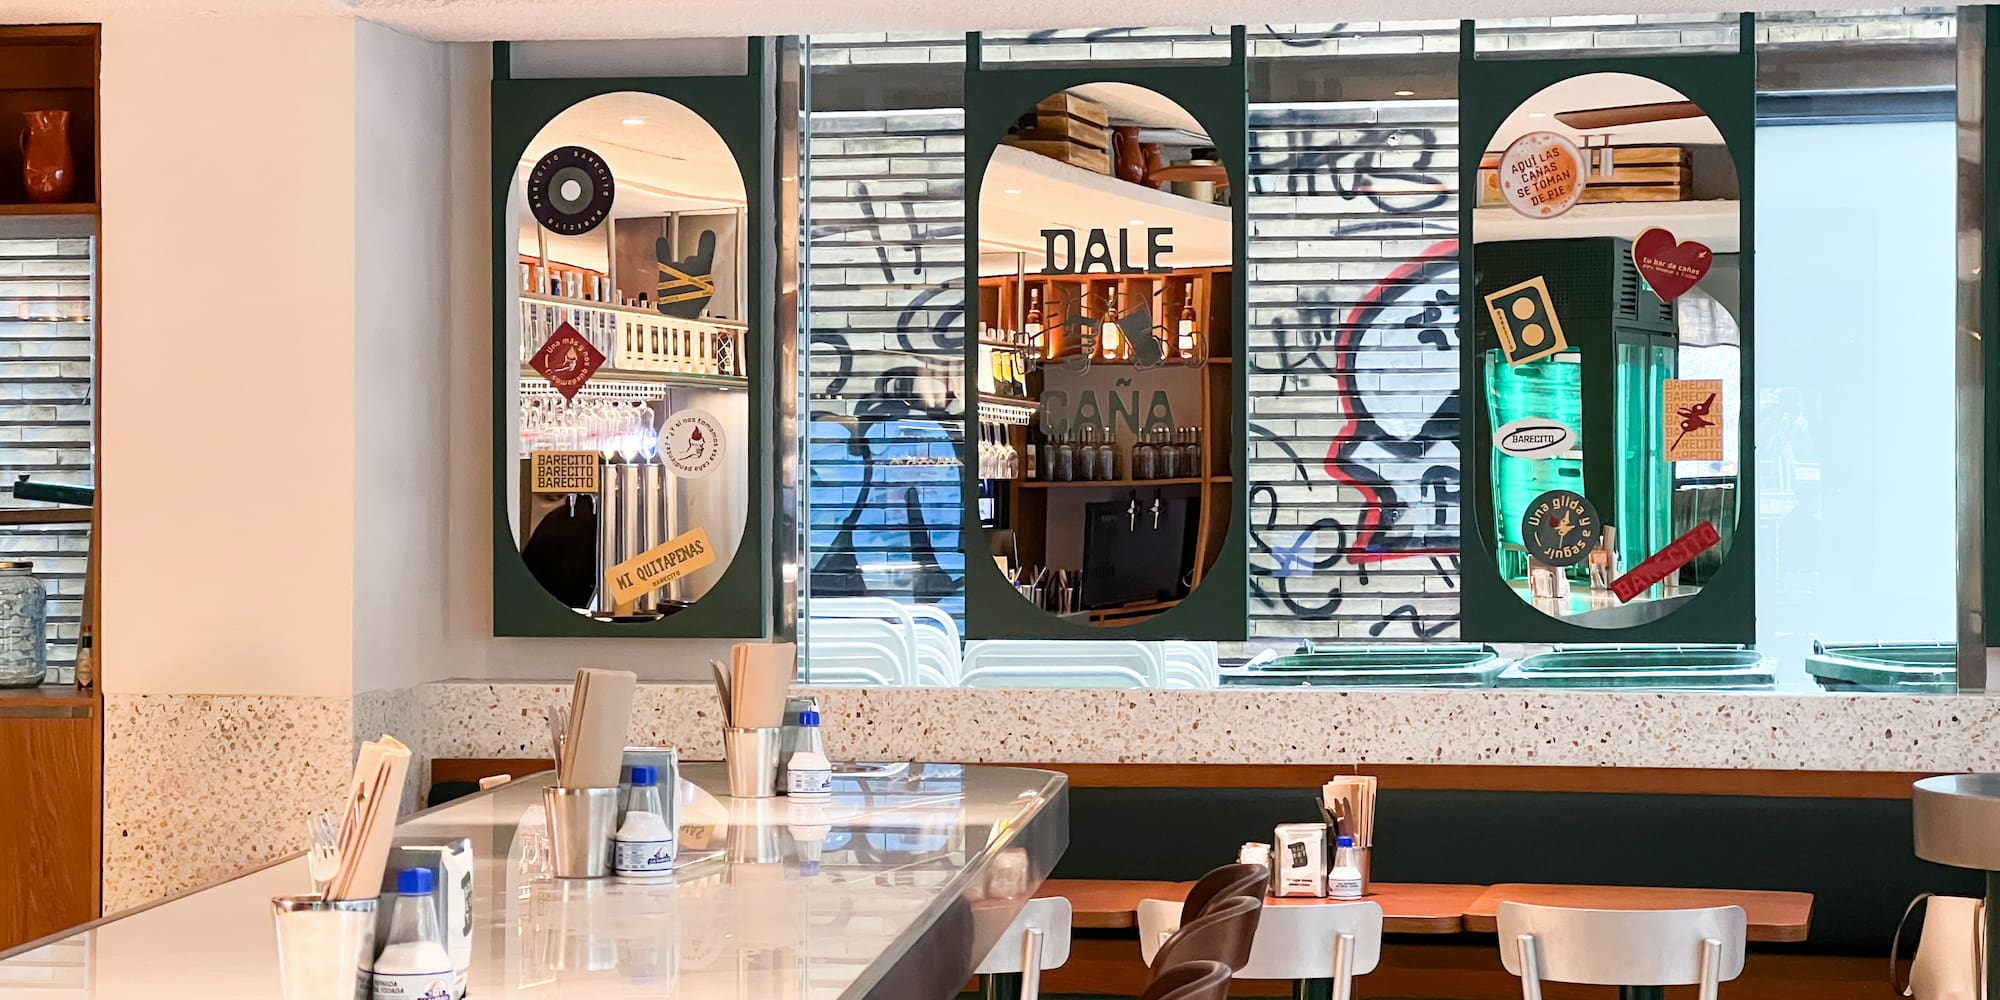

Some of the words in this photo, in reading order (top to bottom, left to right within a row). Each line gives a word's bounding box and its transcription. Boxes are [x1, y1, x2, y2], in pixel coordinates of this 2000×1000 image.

[1512, 154, 1537, 174] AQUÍ
[1539, 148, 1560, 162] LAS
[573, 150, 609, 197] BARECITO
[1522, 162, 1558, 183] CAÑAS
[1517, 186, 1531, 198] SE
[1532, 170, 1570, 192] TOMAN
[1530, 194, 1545, 206] DE
[1548, 186, 1566, 200] PIE
[1040, 227, 1173, 275] DALE
[1653, 259, 1666, 267] bar
[1667, 262, 1677, 270] de
[1678, 264, 1700, 275] cañas
[546, 340, 560, 354] Una
[1040, 378, 1176, 435] CAÑA
[697, 418, 719, 447] tomamos
[1512, 434, 1554, 444] BARECITO
[538, 454, 593, 465] BARECITO
[538, 466, 593, 476] BARECITO
[538, 478, 593, 488] BARECITO
[1528, 502, 1549, 526] Una
[1552, 496, 1585, 515] gilda
[1579, 517, 1591, 527] y
[1582, 529, 1591, 537] a
[1544, 540, 1586, 559] seguir
[616, 572, 634, 591] MI
[636, 540, 704, 582] QUITAPENAS
[652, 570, 681, 587] BARECITO
